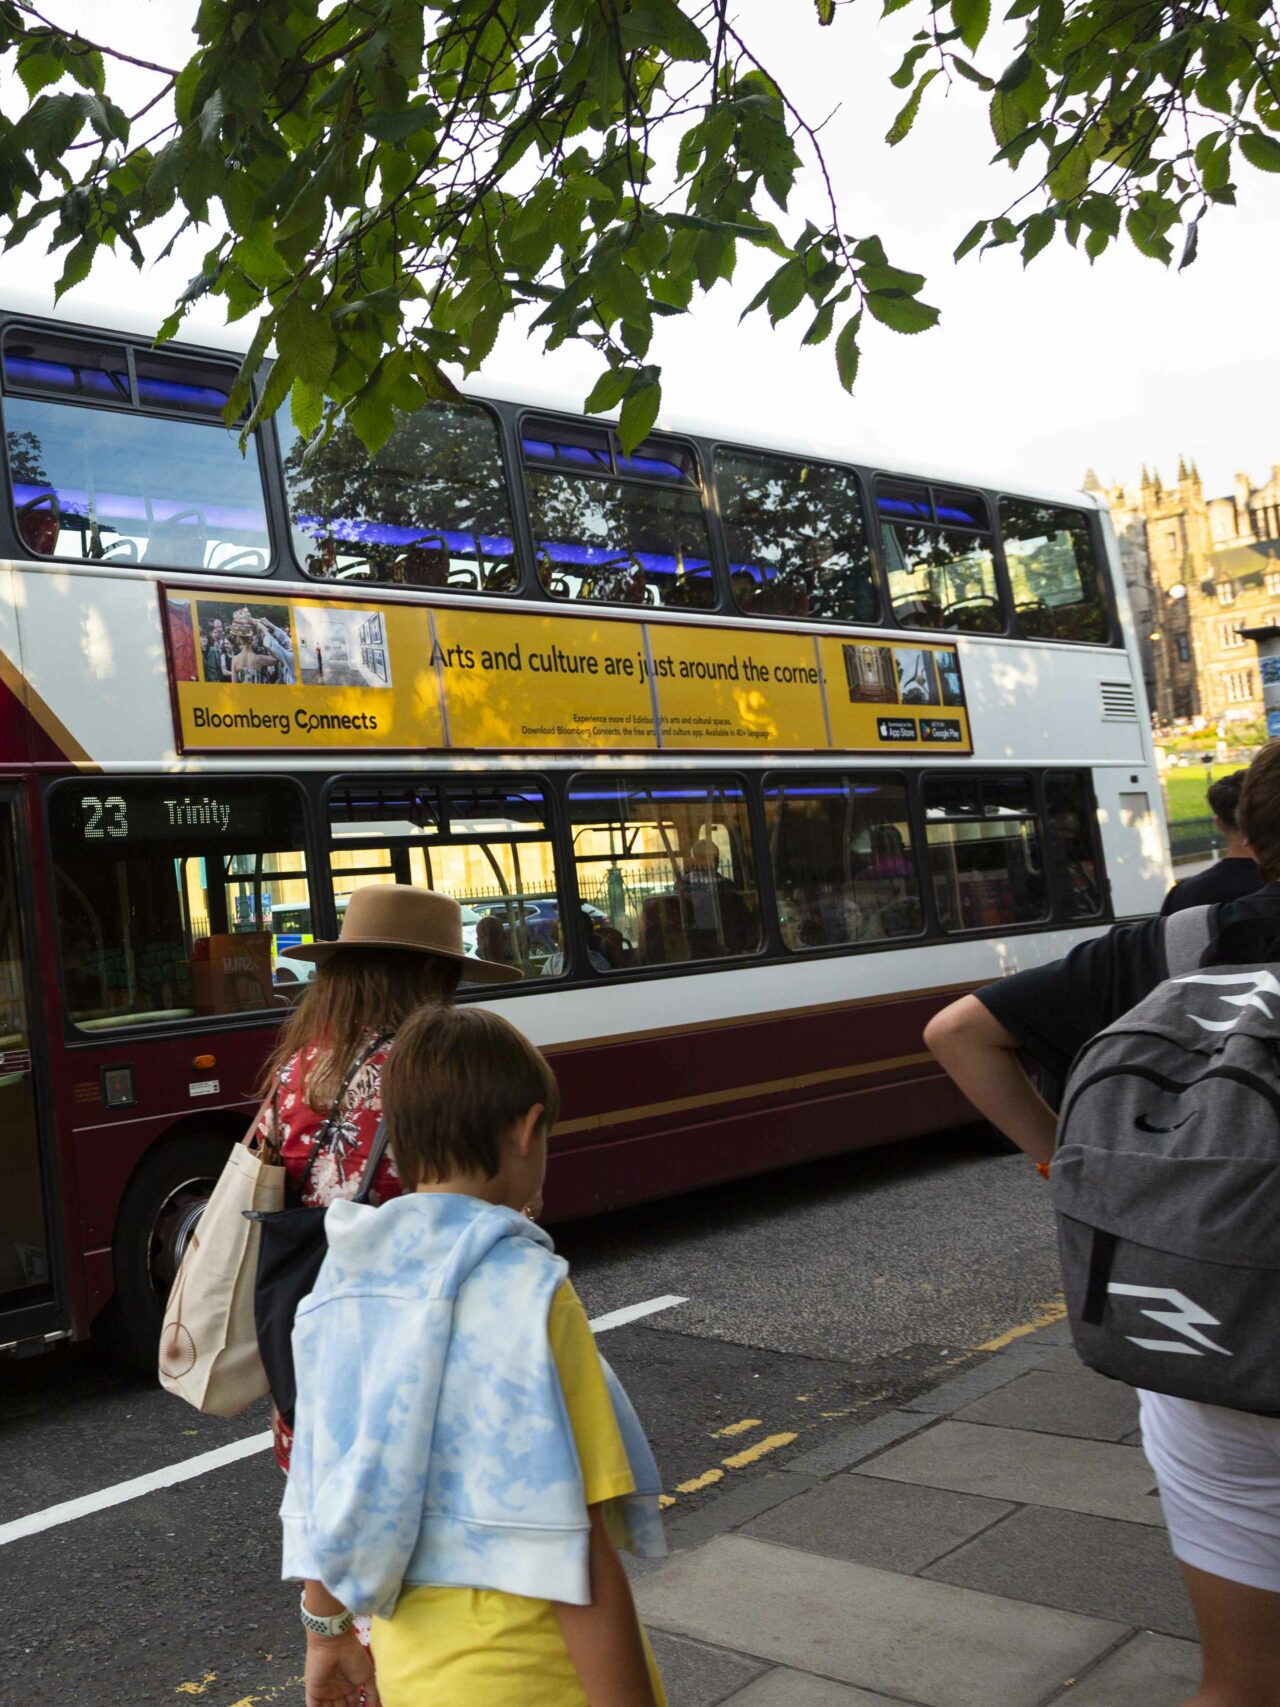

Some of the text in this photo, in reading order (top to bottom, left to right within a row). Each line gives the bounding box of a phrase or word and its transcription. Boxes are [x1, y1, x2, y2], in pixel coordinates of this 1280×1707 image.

[429, 641, 474, 669] Arts
[481, 644, 523, 671] and
[528, 646, 599, 674] culture
[604, 657, 634, 676] are
[637, 652, 675, 684] just
[680, 654, 740, 681] around
[742, 656, 770, 683] the
[193, 706, 378, 735] Bloomberg Connects
[573, 713, 607, 724] Experience
[681, 716, 692, 724] and
[693, 716, 711, 725] cultural
[521, 725, 555, 735] Download
[556, 726, 592, 737] Bloomberg
[623, 727, 632, 735] the
[889, 728, 915, 739] App Store
[932, 728, 960, 740] Google Play
[81, 796, 230, 838] 23 Trinity
